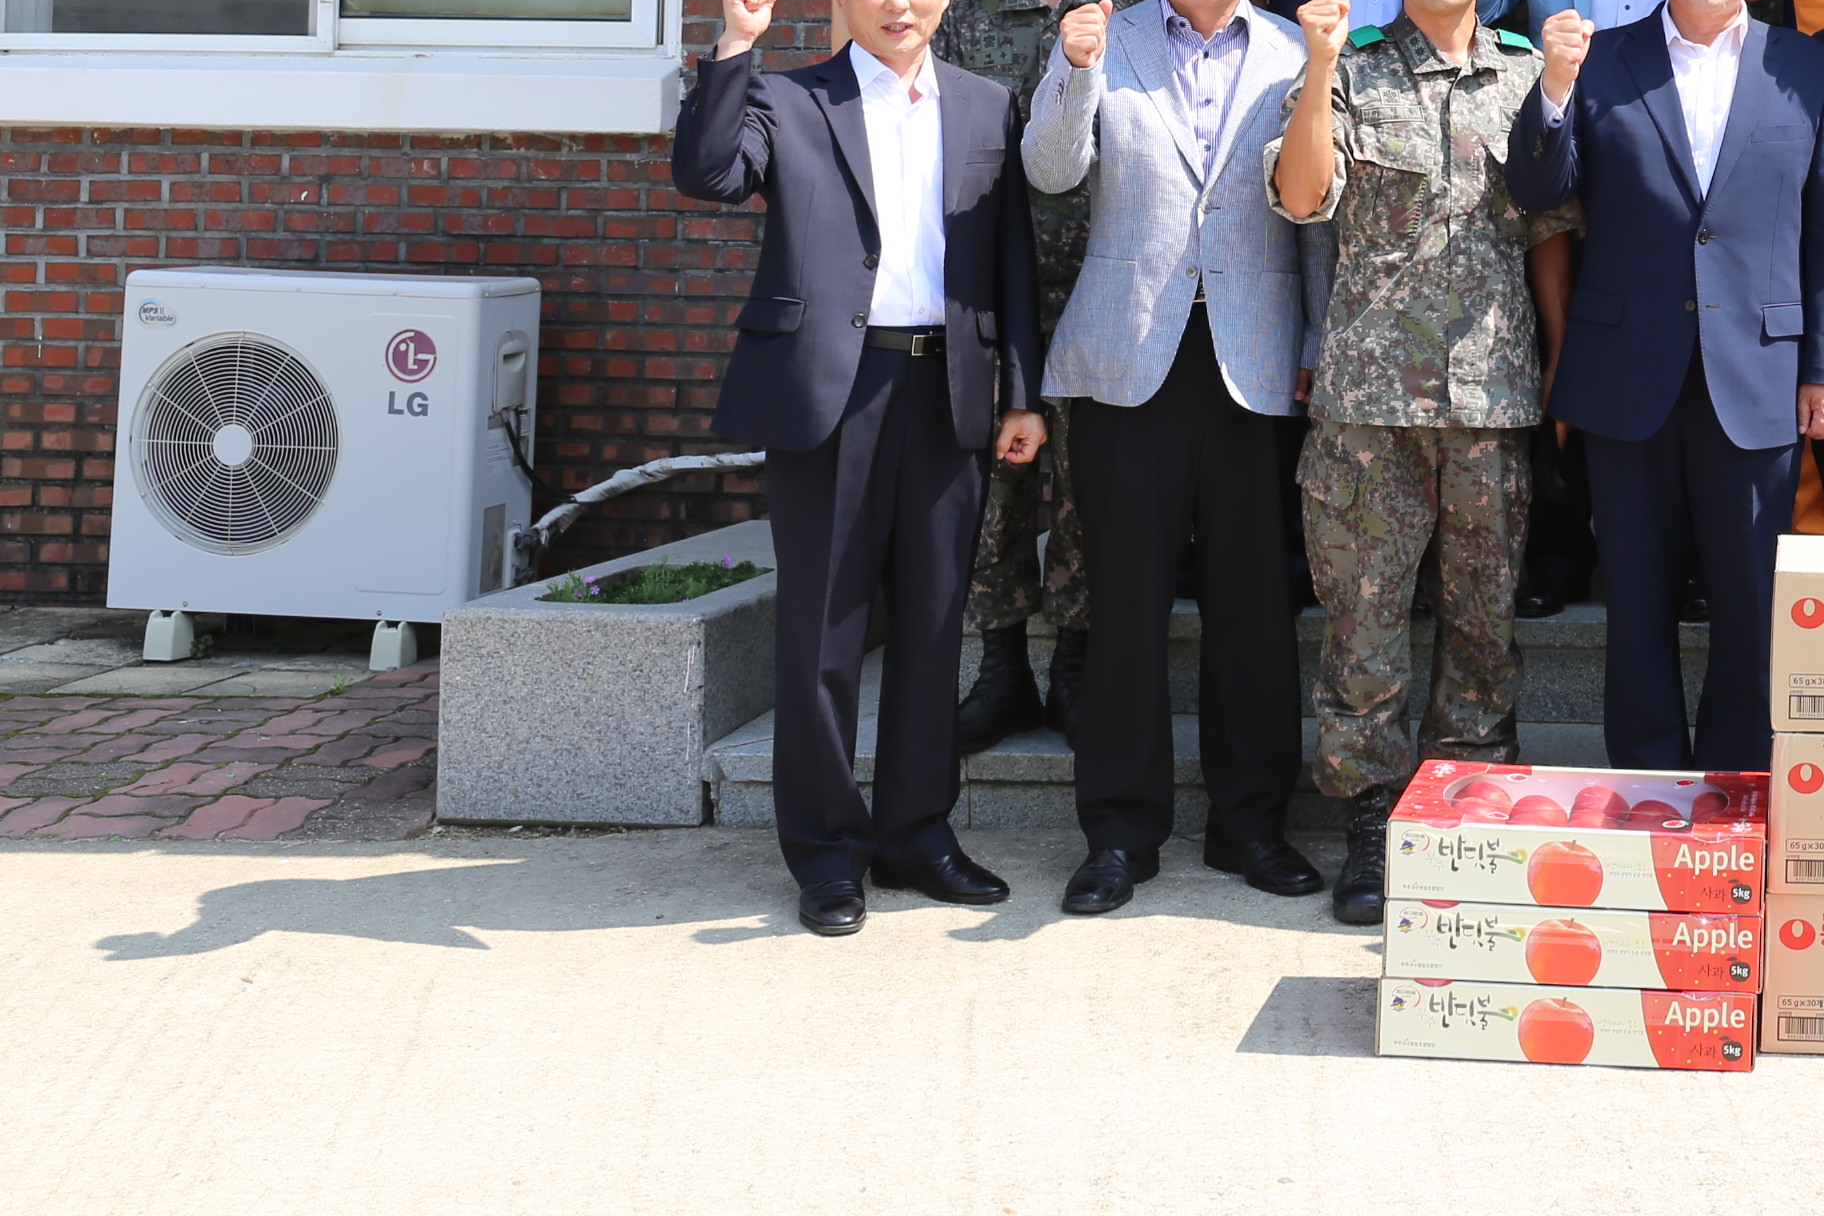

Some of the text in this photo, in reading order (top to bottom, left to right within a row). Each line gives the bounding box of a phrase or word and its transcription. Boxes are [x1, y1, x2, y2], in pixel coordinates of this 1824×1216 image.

[388, 390, 429, 417] LG
[1673, 843, 1755, 876] Apple
[1700, 886, 1751, 902] 사과 5kg
[1672, 922, 1753, 954] Apple
[1697, 964, 1749, 979] 사과 5kg
[1664, 1000, 1746, 1033] Apple
[1691, 1044, 1742, 1059] 사과 5kg
